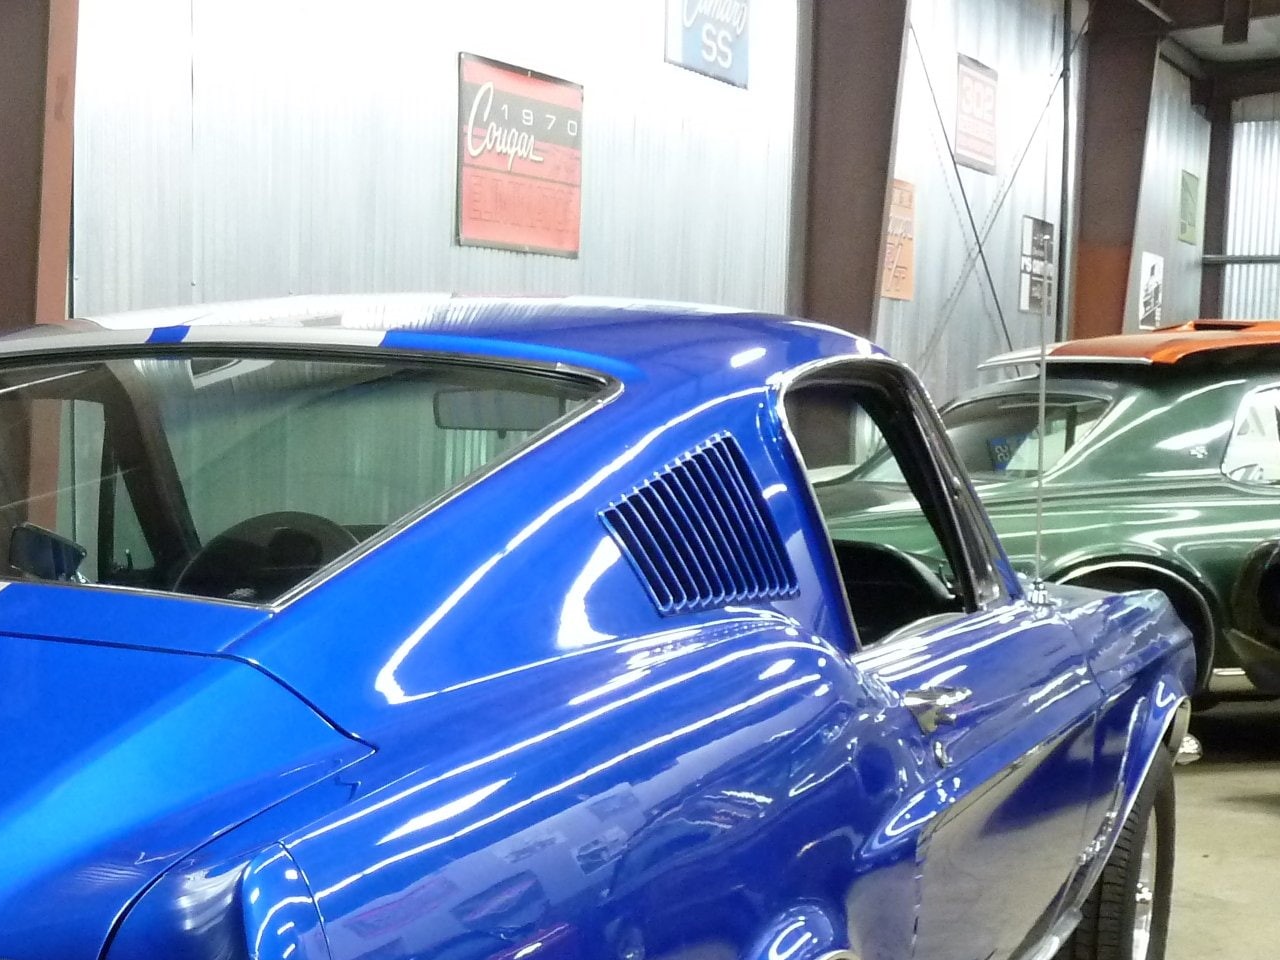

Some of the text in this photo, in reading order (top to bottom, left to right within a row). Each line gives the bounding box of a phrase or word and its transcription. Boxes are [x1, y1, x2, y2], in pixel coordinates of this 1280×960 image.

[701, 22, 732, 69] SS
[467, 81, 544, 171] Cougar
[501, 104, 578, 136] 1970
